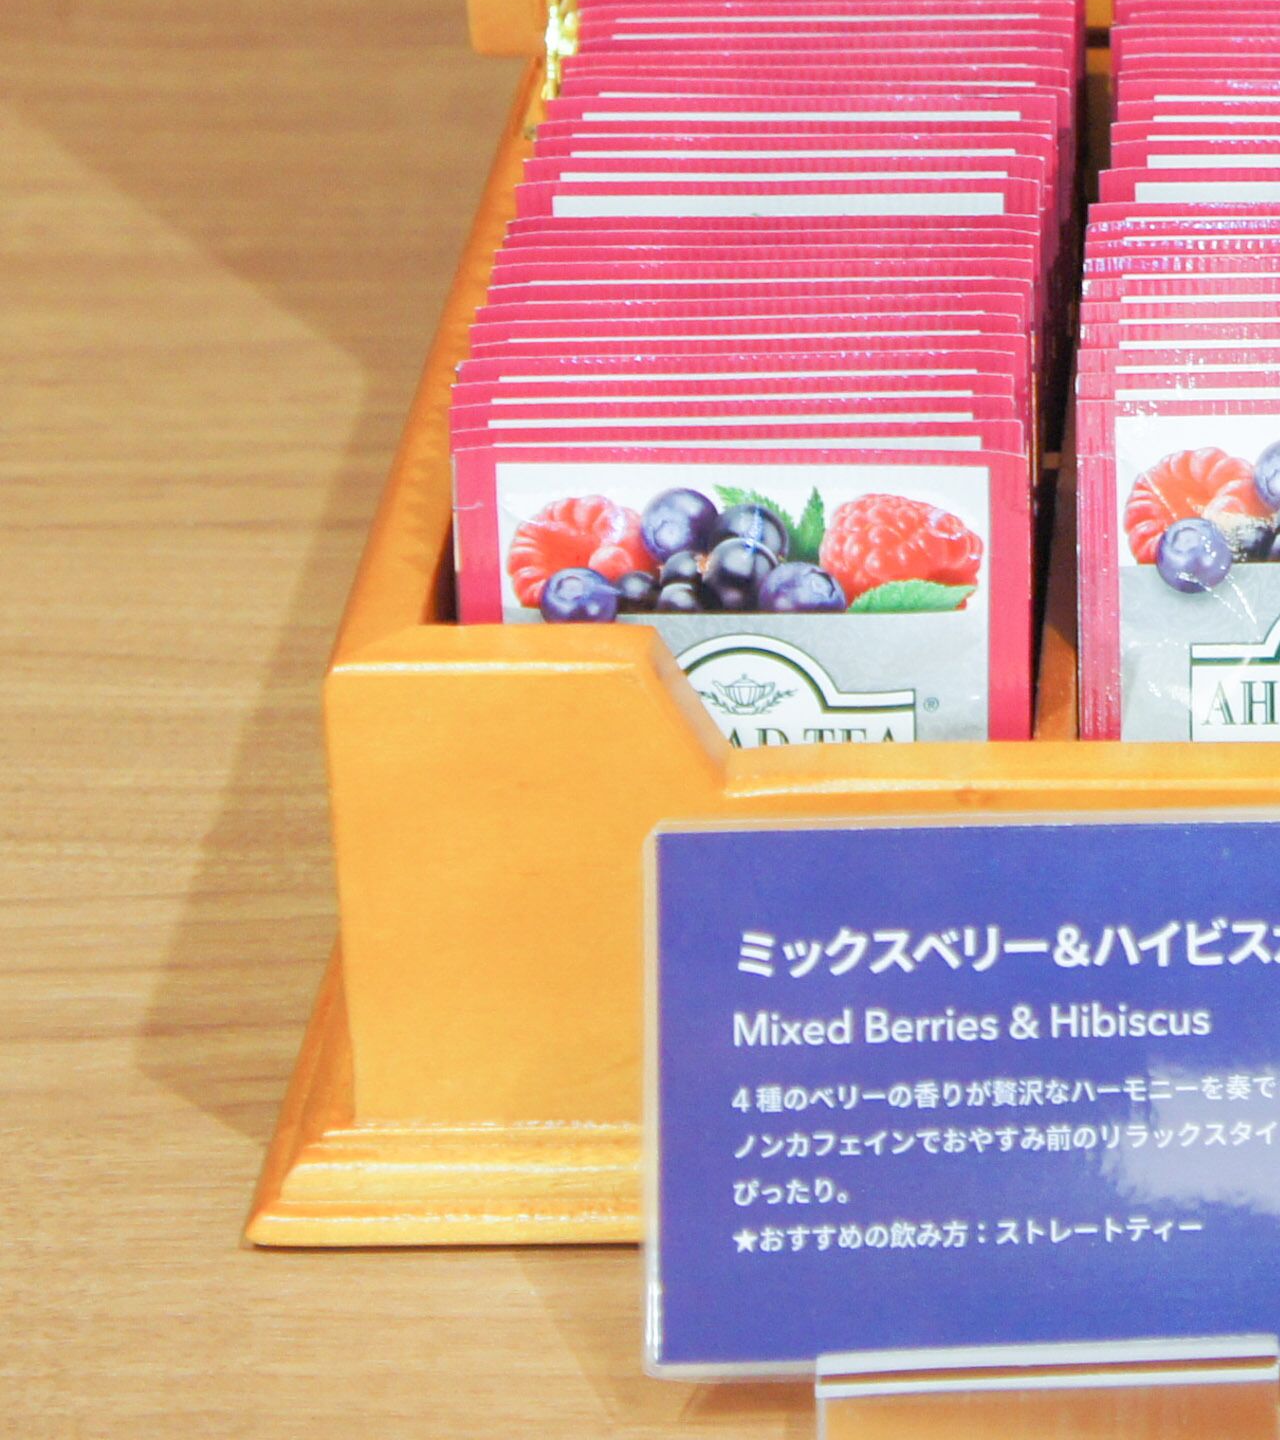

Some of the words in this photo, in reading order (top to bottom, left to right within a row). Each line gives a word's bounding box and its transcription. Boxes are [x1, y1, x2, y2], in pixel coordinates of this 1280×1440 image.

[732, 1009, 853, 1048] Mixed
[864, 1007, 998, 1044] Berries
[1010, 1006, 1040, 1041] &
[1050, 1003, 1213, 1040] Hibiscus
